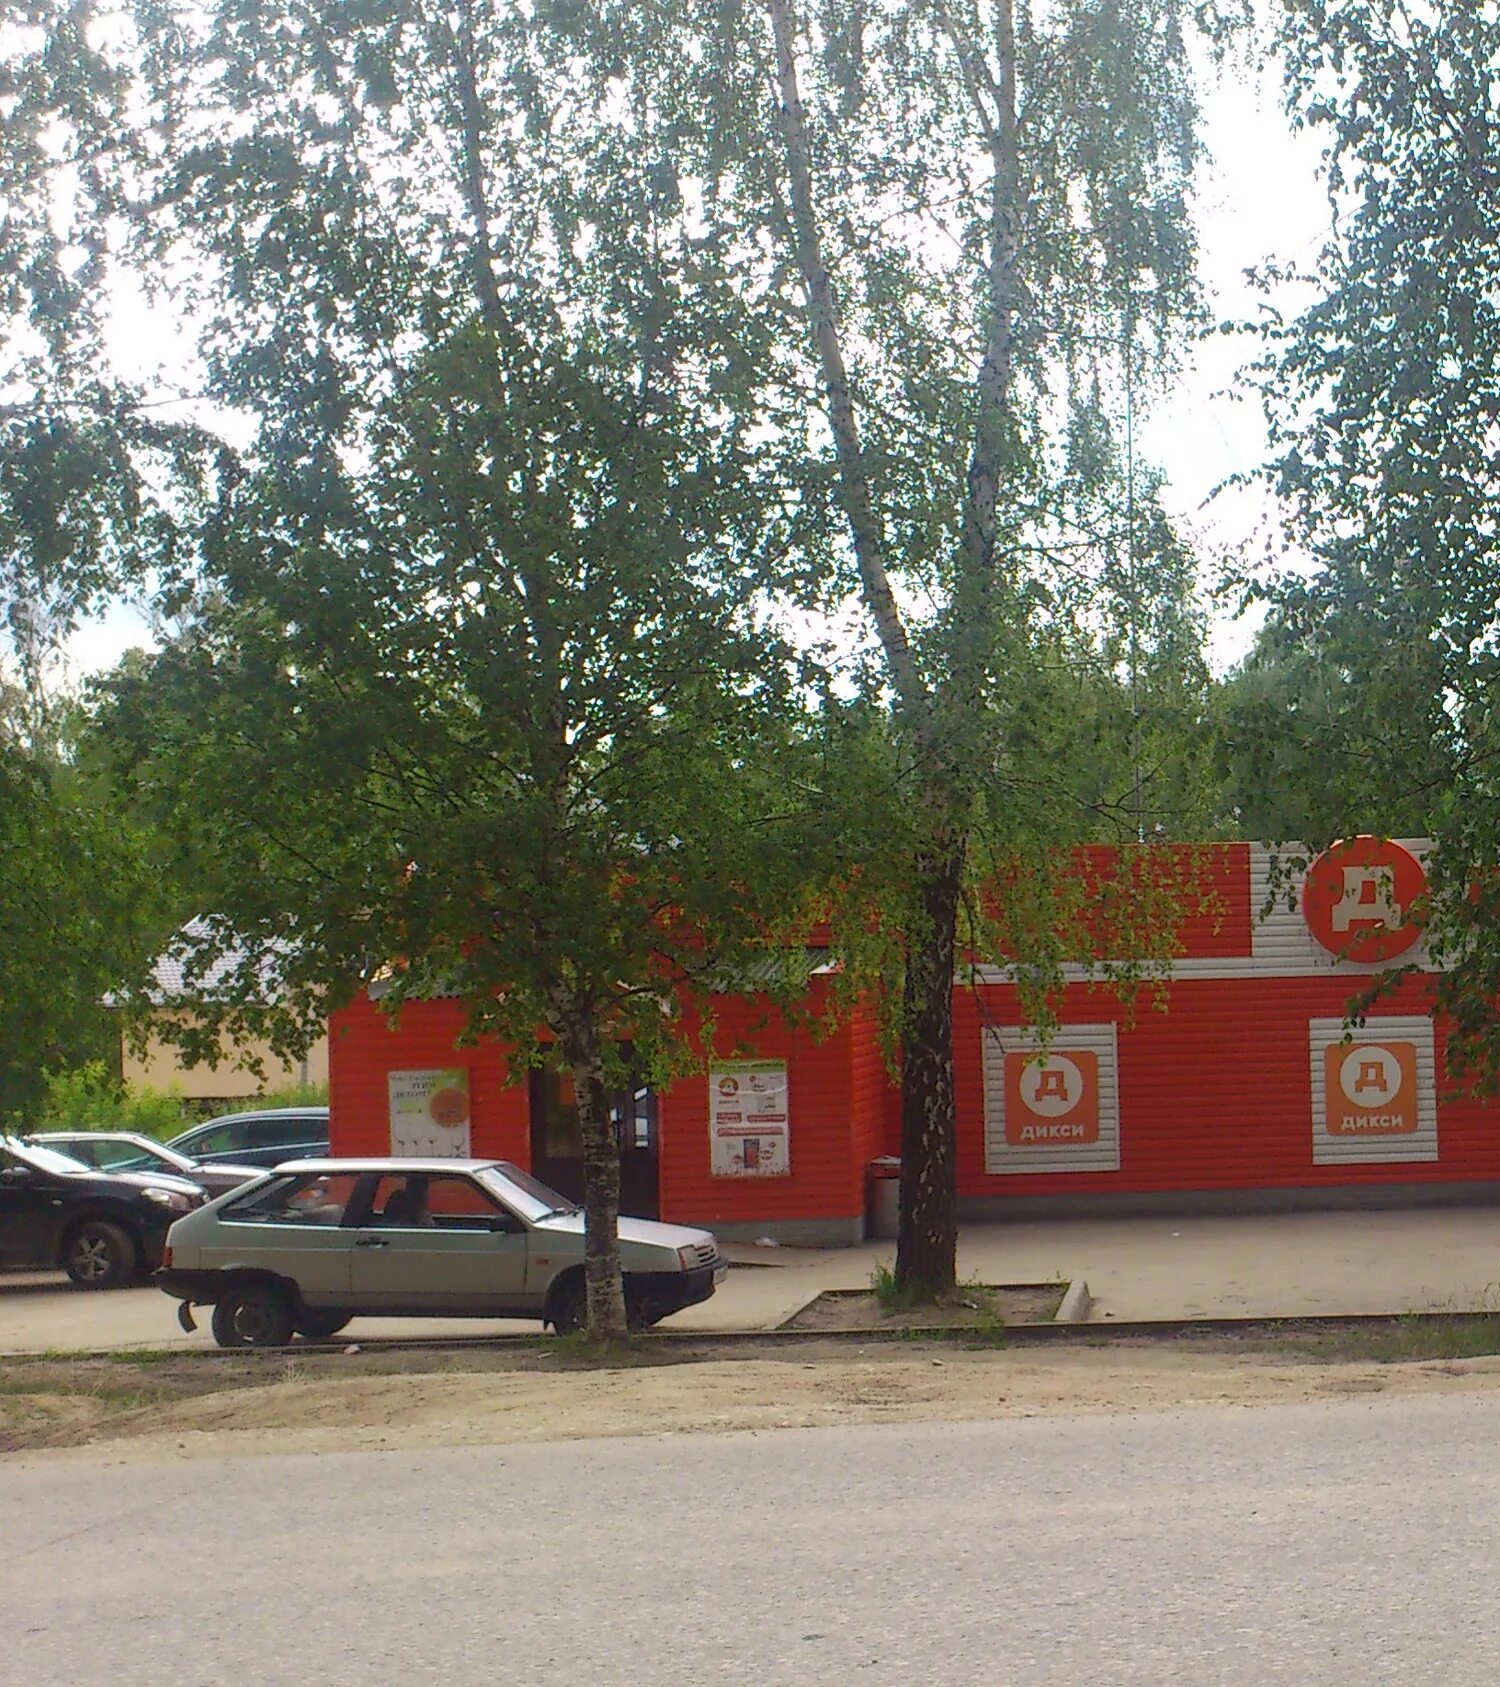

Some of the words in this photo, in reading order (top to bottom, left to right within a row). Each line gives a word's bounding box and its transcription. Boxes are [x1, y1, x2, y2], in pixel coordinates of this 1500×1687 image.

[1331, 867, 1402, 932] Д
[1035, 1071, 1068, 1101] Д
[1355, 1062, 1387, 1092] Д
[1021, 1125, 1084, 1140] ДИКСИ
[1341, 1115, 1403, 1130] ДИКСИ
